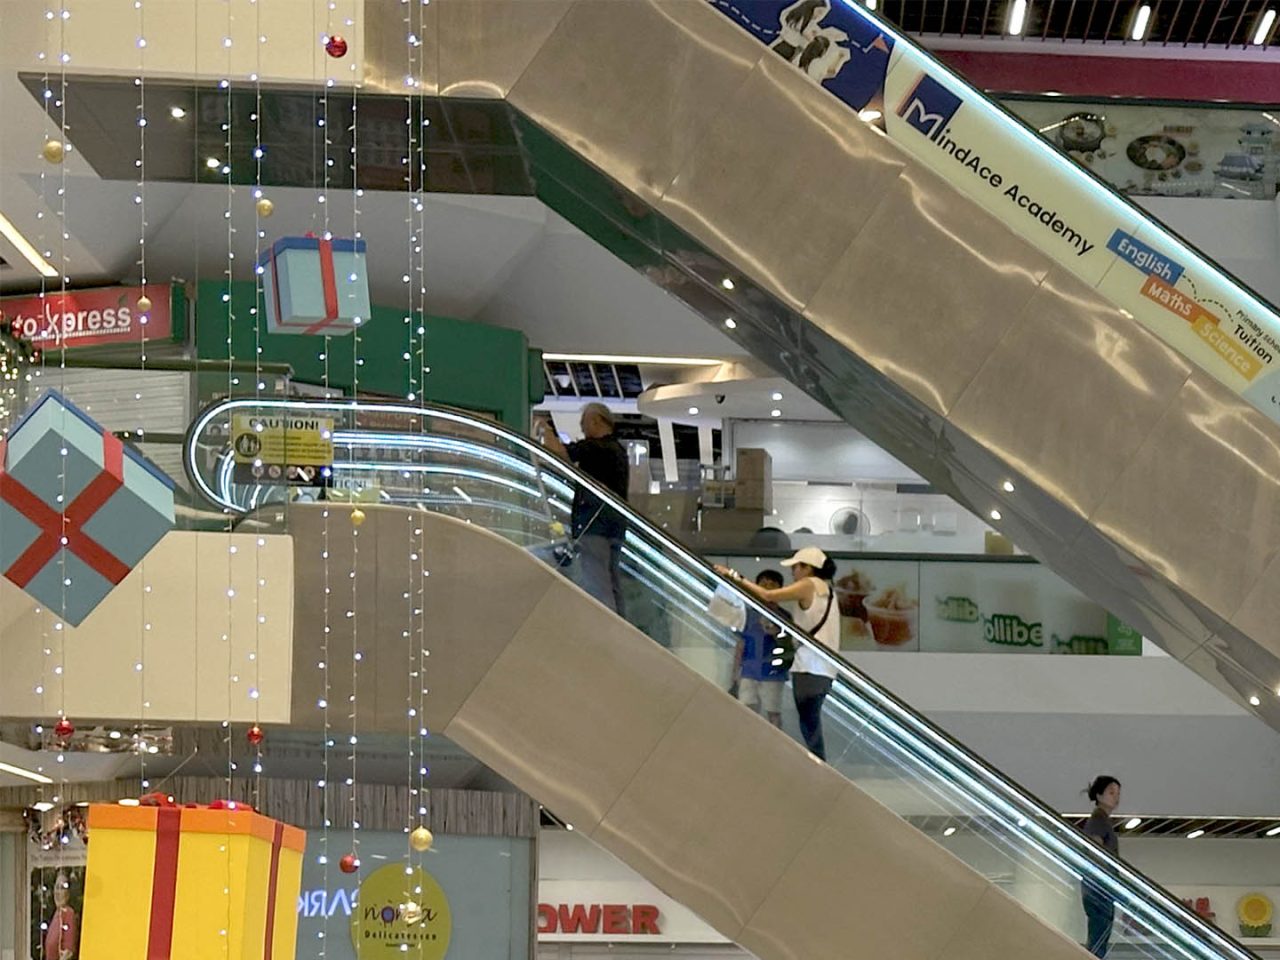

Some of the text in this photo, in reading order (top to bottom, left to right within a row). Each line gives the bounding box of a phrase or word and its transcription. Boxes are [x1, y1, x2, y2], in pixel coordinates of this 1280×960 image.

[900, 92, 1094, 256] MindAce Academy
[1117, 238, 1173, 281] English
[1148, 282, 1193, 316] Maths
[1200, 324, 1252, 373] Science
[1234, 323, 1273, 364] Tuition
[249, 418, 319, 431] CAUTION!
[537, 903, 661, 934] OWER
